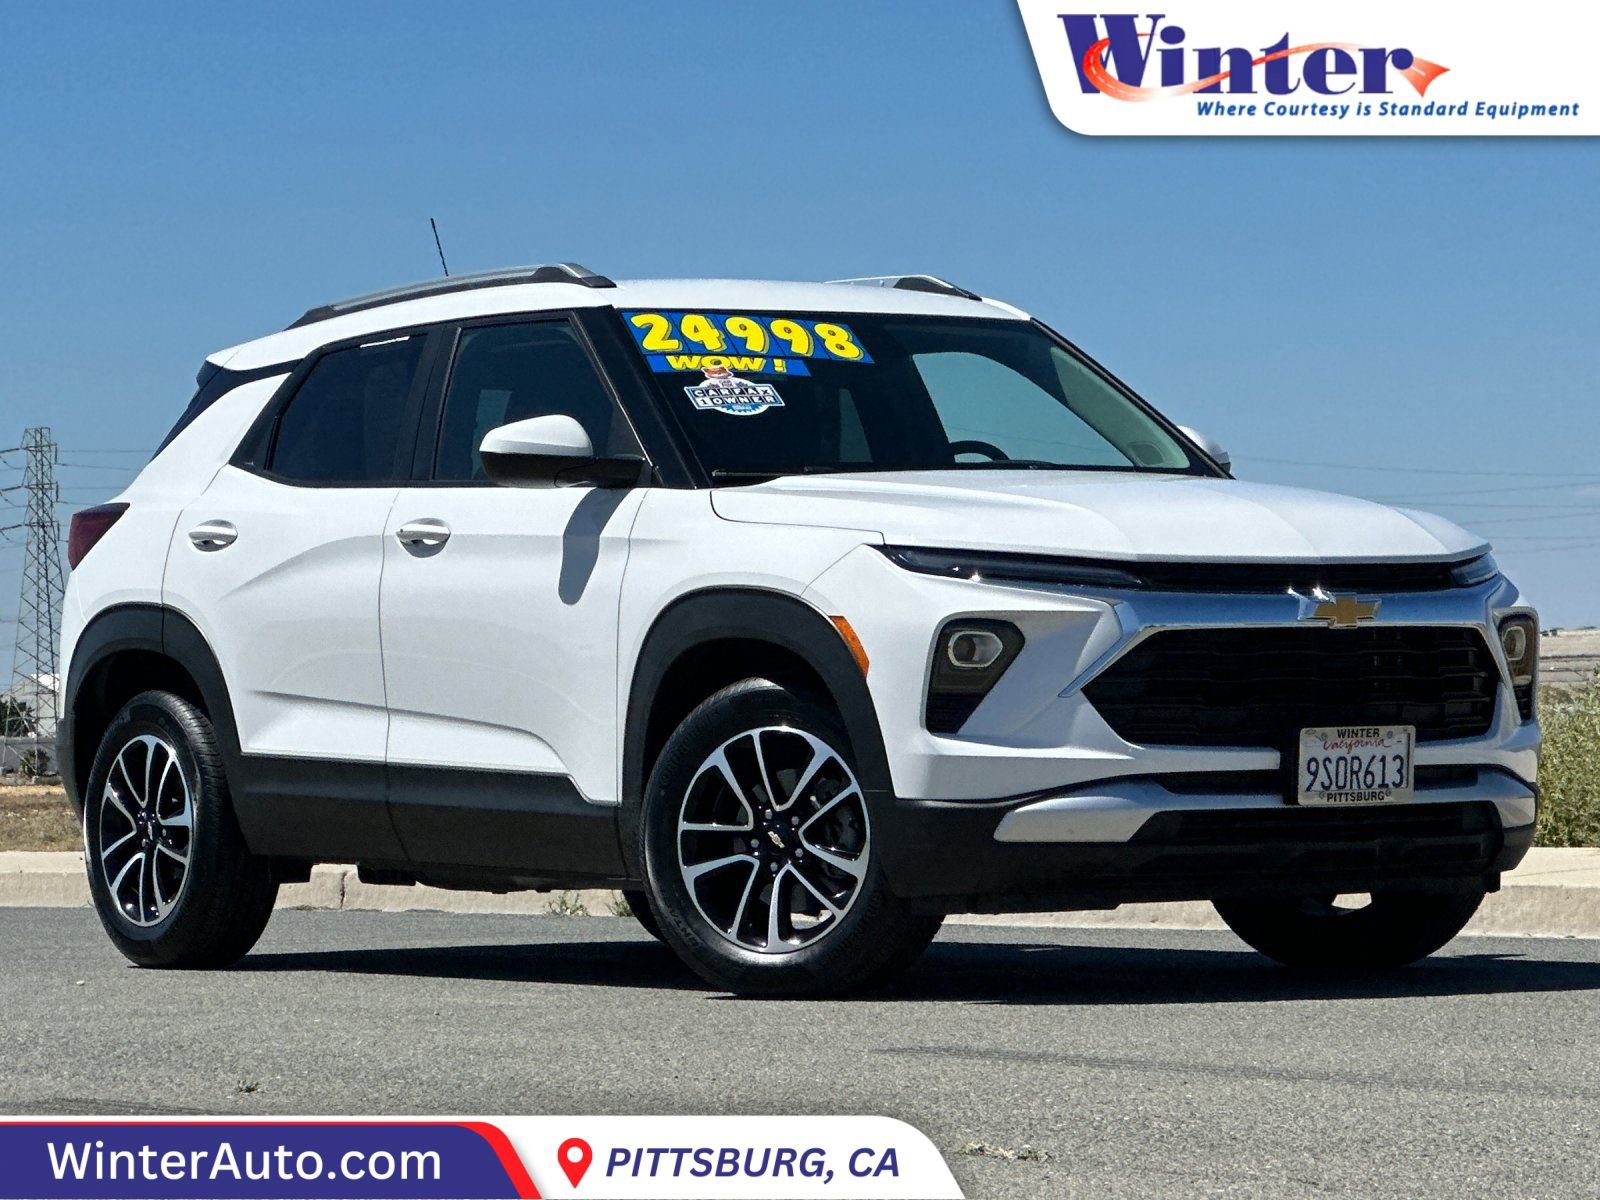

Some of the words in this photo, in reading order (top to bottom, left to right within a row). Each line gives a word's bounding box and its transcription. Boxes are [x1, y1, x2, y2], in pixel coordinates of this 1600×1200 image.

[630, 313, 862, 360] 24998
[693, 387, 771, 397] CARFAX
[712, 396, 776, 405] OWNER
[1336, 727, 1380, 739] WINTER
[1322, 739, 1392, 755] California
[1304, 754, 1405, 793] 9SOR613
[1326, 790, 1386, 803] PITTSBURG
